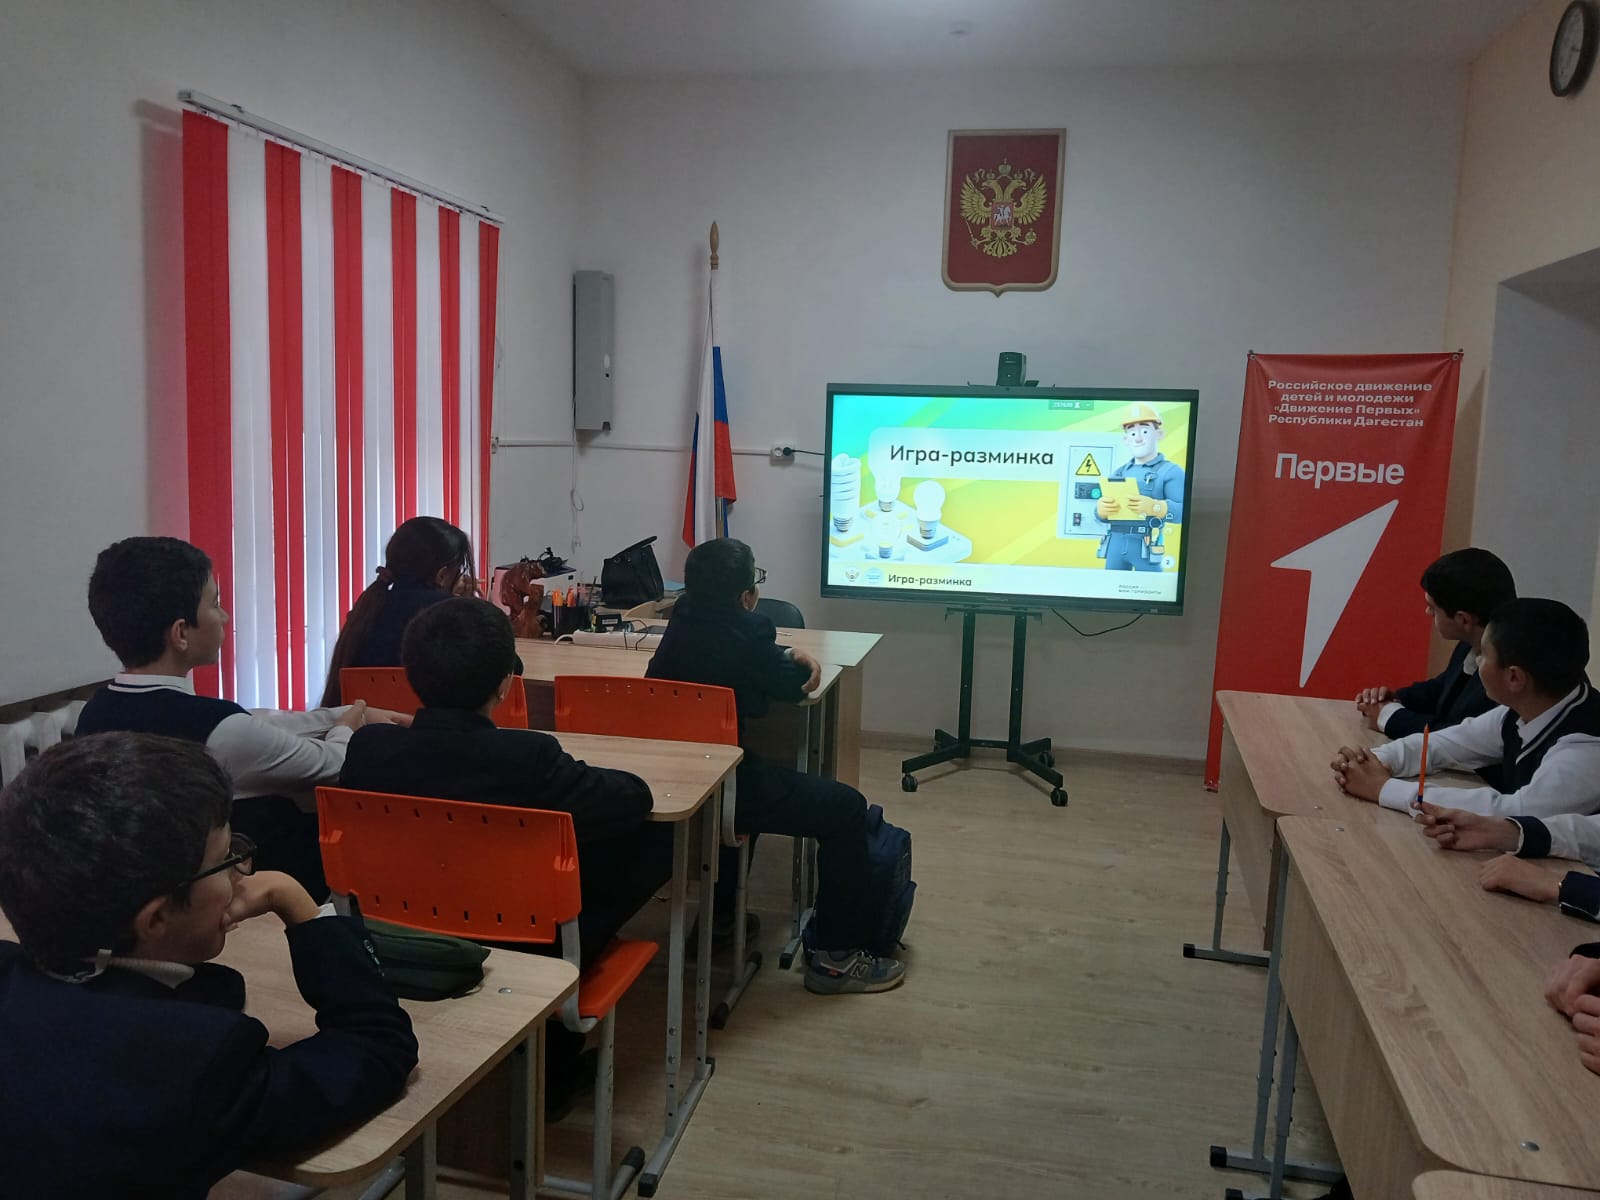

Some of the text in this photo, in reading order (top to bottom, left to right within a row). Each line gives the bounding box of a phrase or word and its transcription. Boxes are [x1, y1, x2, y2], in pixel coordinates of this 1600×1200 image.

[1268, 380, 1433, 392] Российское движение
[1280, 392, 1415, 404] детей и молодежи
[1268, 414, 1424, 427] Республики Дагестан
[890, 444, 1054, 467] Игра-разминка
[1275, 453, 1405, 489] Первые
[888, 574, 972, 586] Игра-разминка
[850, 963, 868, 977] N
